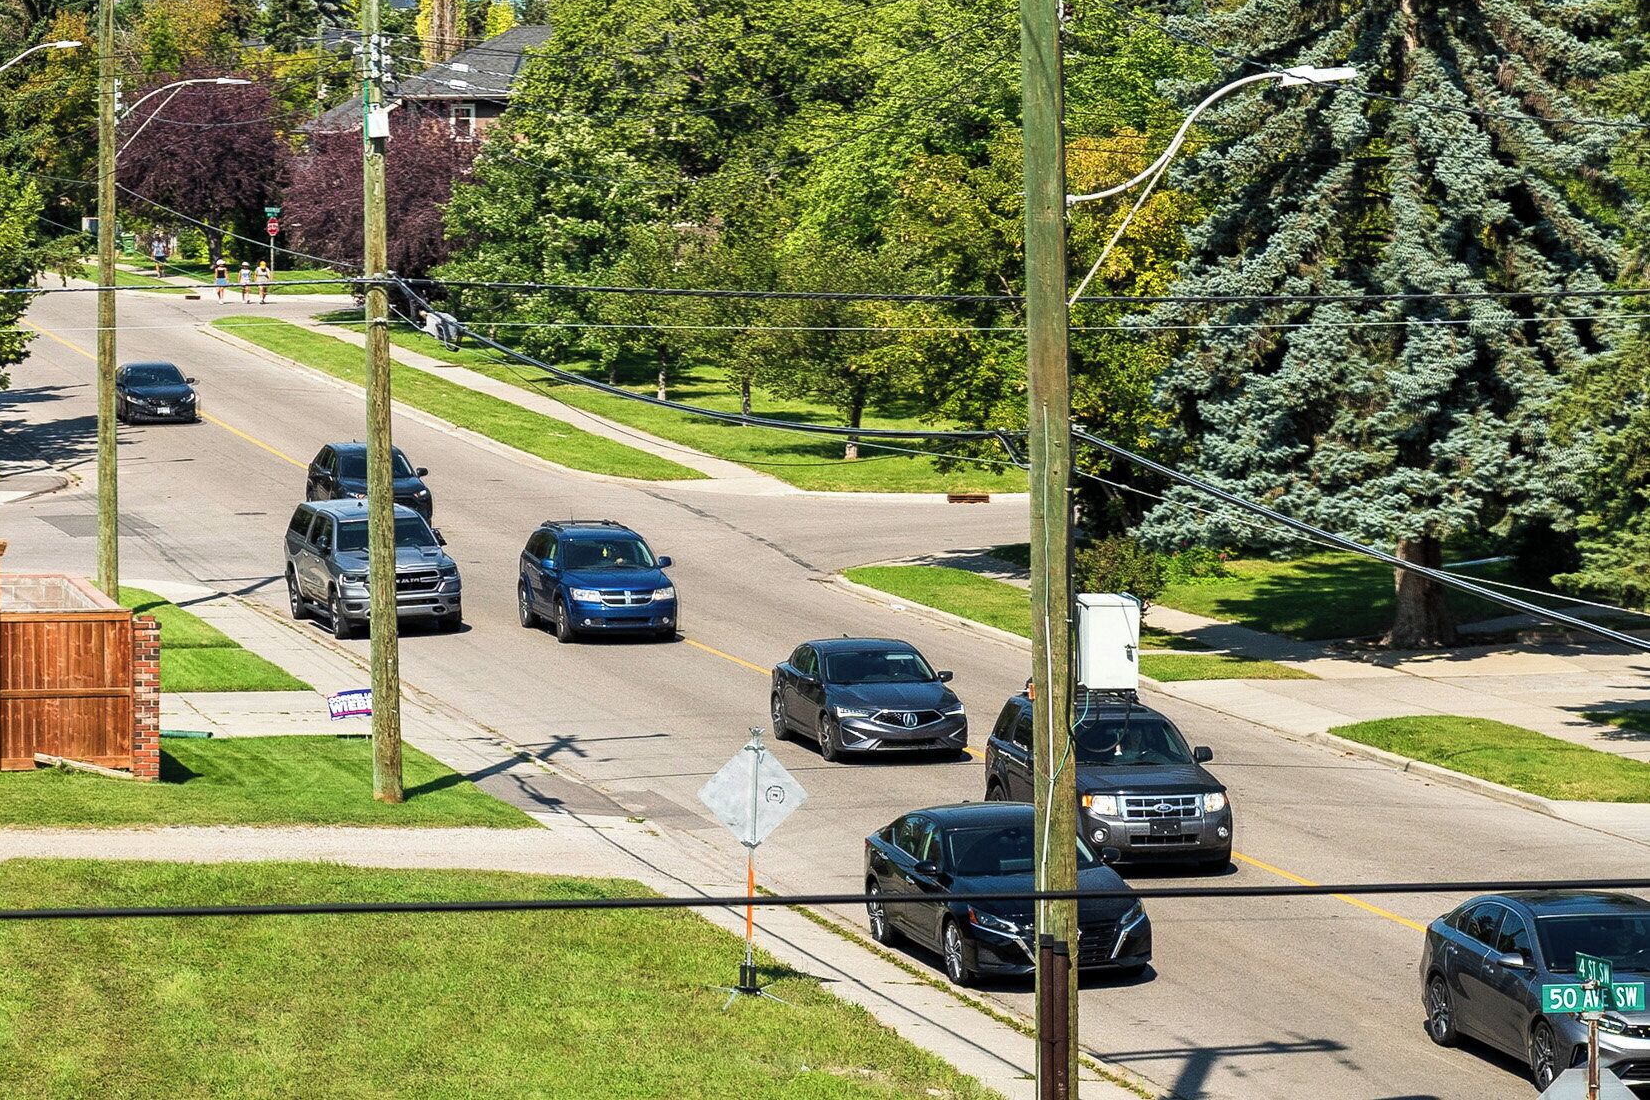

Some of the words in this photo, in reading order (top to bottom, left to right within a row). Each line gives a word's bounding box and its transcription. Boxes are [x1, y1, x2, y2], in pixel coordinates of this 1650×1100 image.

[1579, 958, 1585, 978] 4
[1588, 959, 1596, 980] ST
[1599, 963, 1609, 983] SW
[1550, 988, 1577, 1009] 50
[1583, 988, 1609, 1008] AVE
[1616, 986, 1638, 1008] SW
